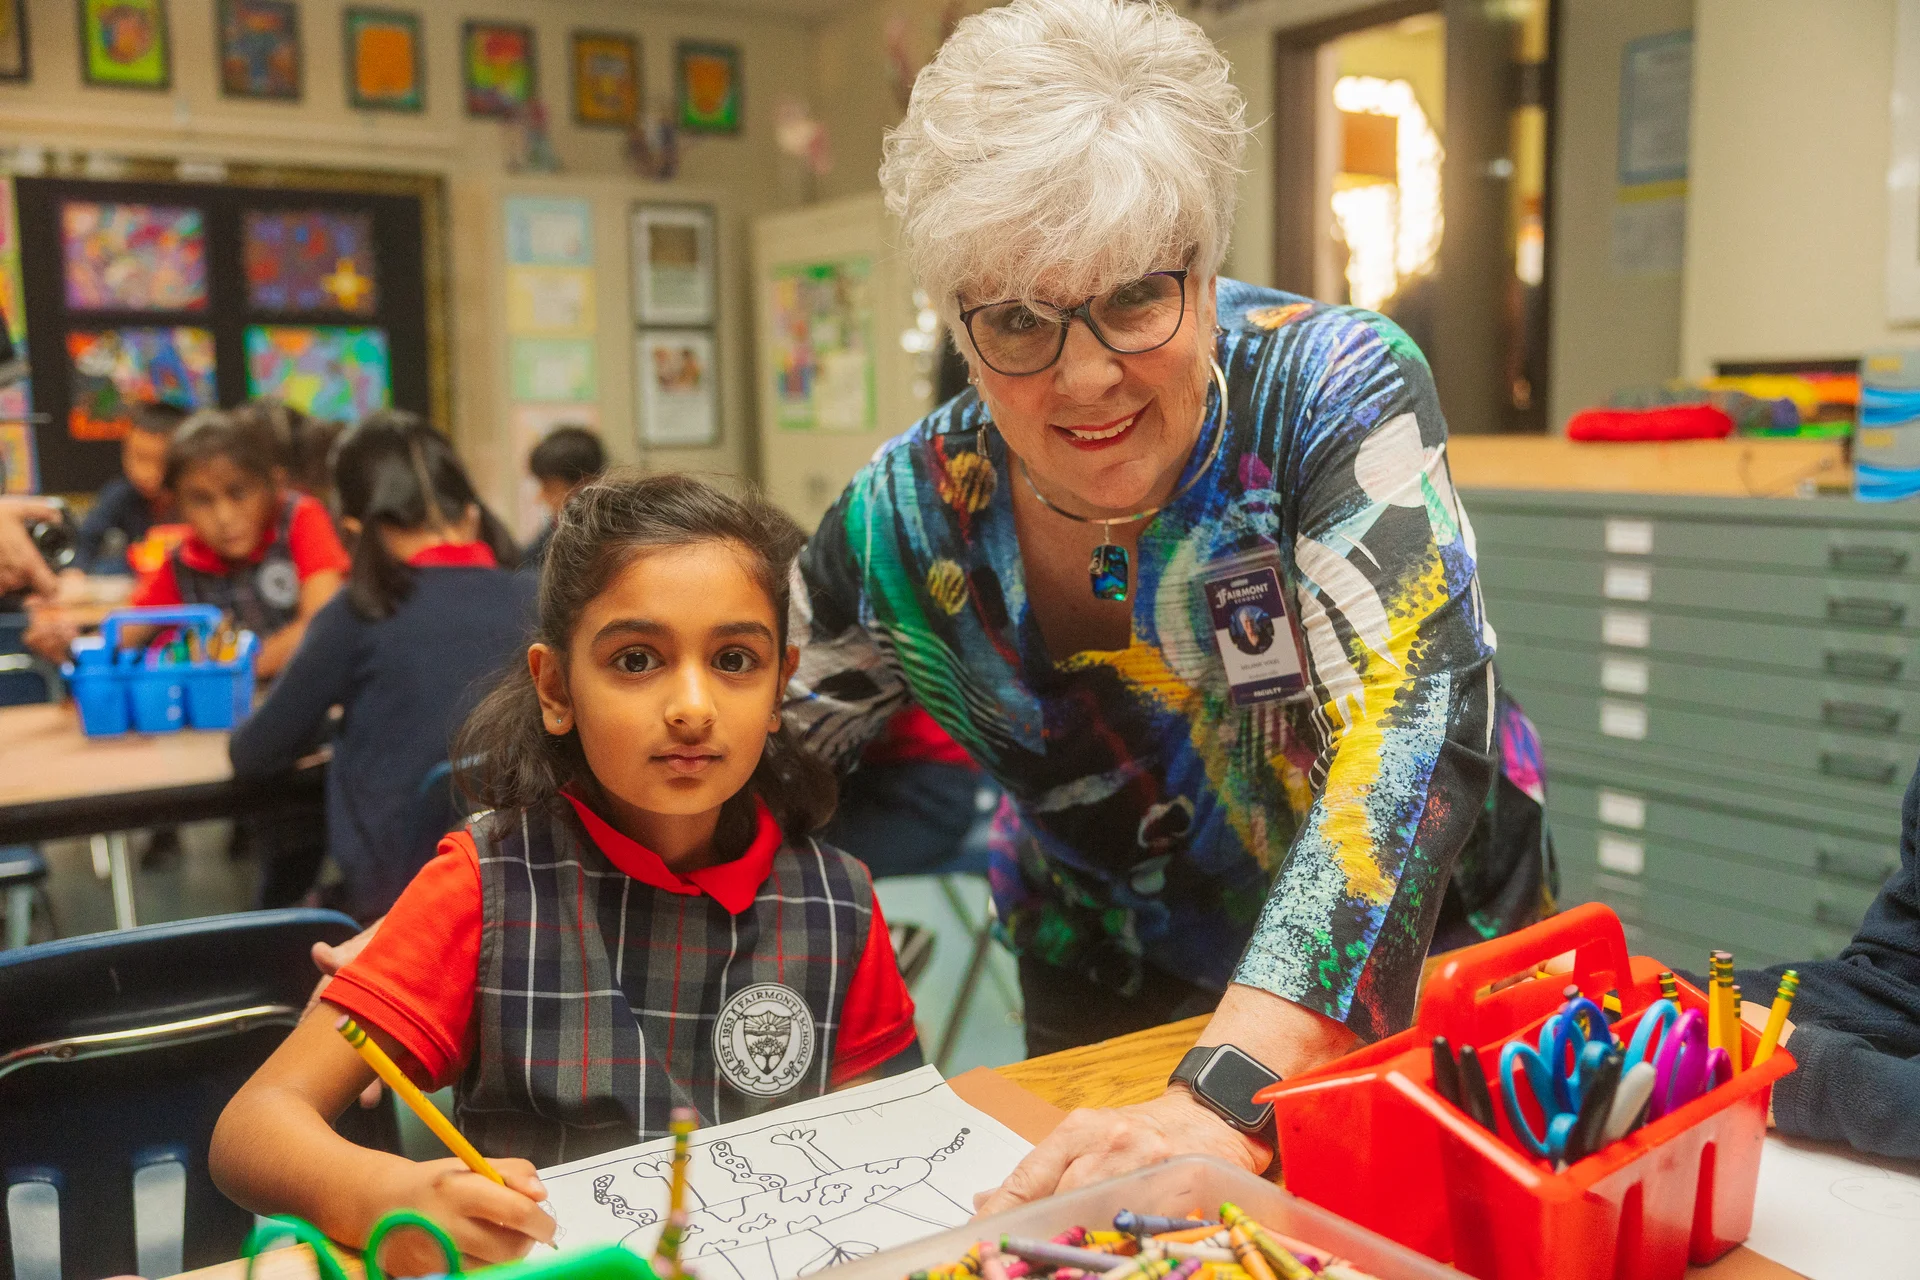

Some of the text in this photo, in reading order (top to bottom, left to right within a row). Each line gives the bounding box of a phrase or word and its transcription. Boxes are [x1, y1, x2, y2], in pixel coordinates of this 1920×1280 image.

[1215, 583, 1268, 608] FAIRMONT
[722, 1017, 735, 1038] 1953
[737, 991, 798, 1010] FAIRMONT
[797, 1017, 809, 1067] SCHOOLS
